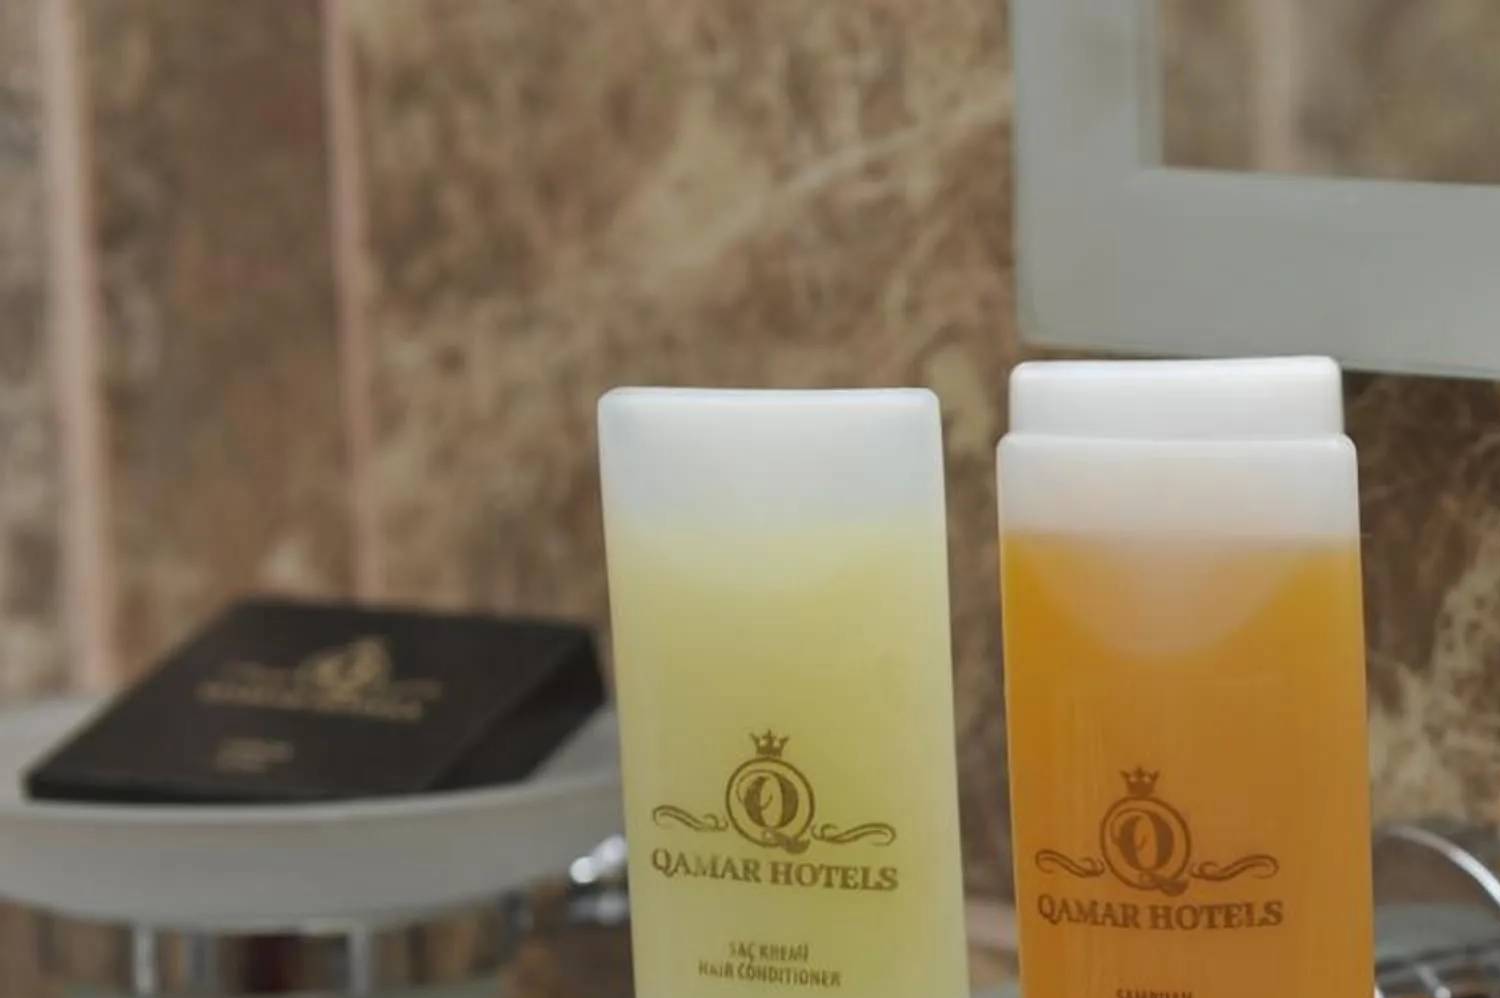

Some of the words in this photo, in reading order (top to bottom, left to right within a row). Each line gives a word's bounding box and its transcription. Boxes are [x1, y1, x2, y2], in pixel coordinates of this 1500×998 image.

[651, 848, 762, 884] QAMAR
[769, 860, 899, 892] HOTELS
[1036, 892, 1141, 929] QAMAR
[1147, 900, 1284, 931] HOTELS
[737, 963, 842, 989] CONDITIONER
